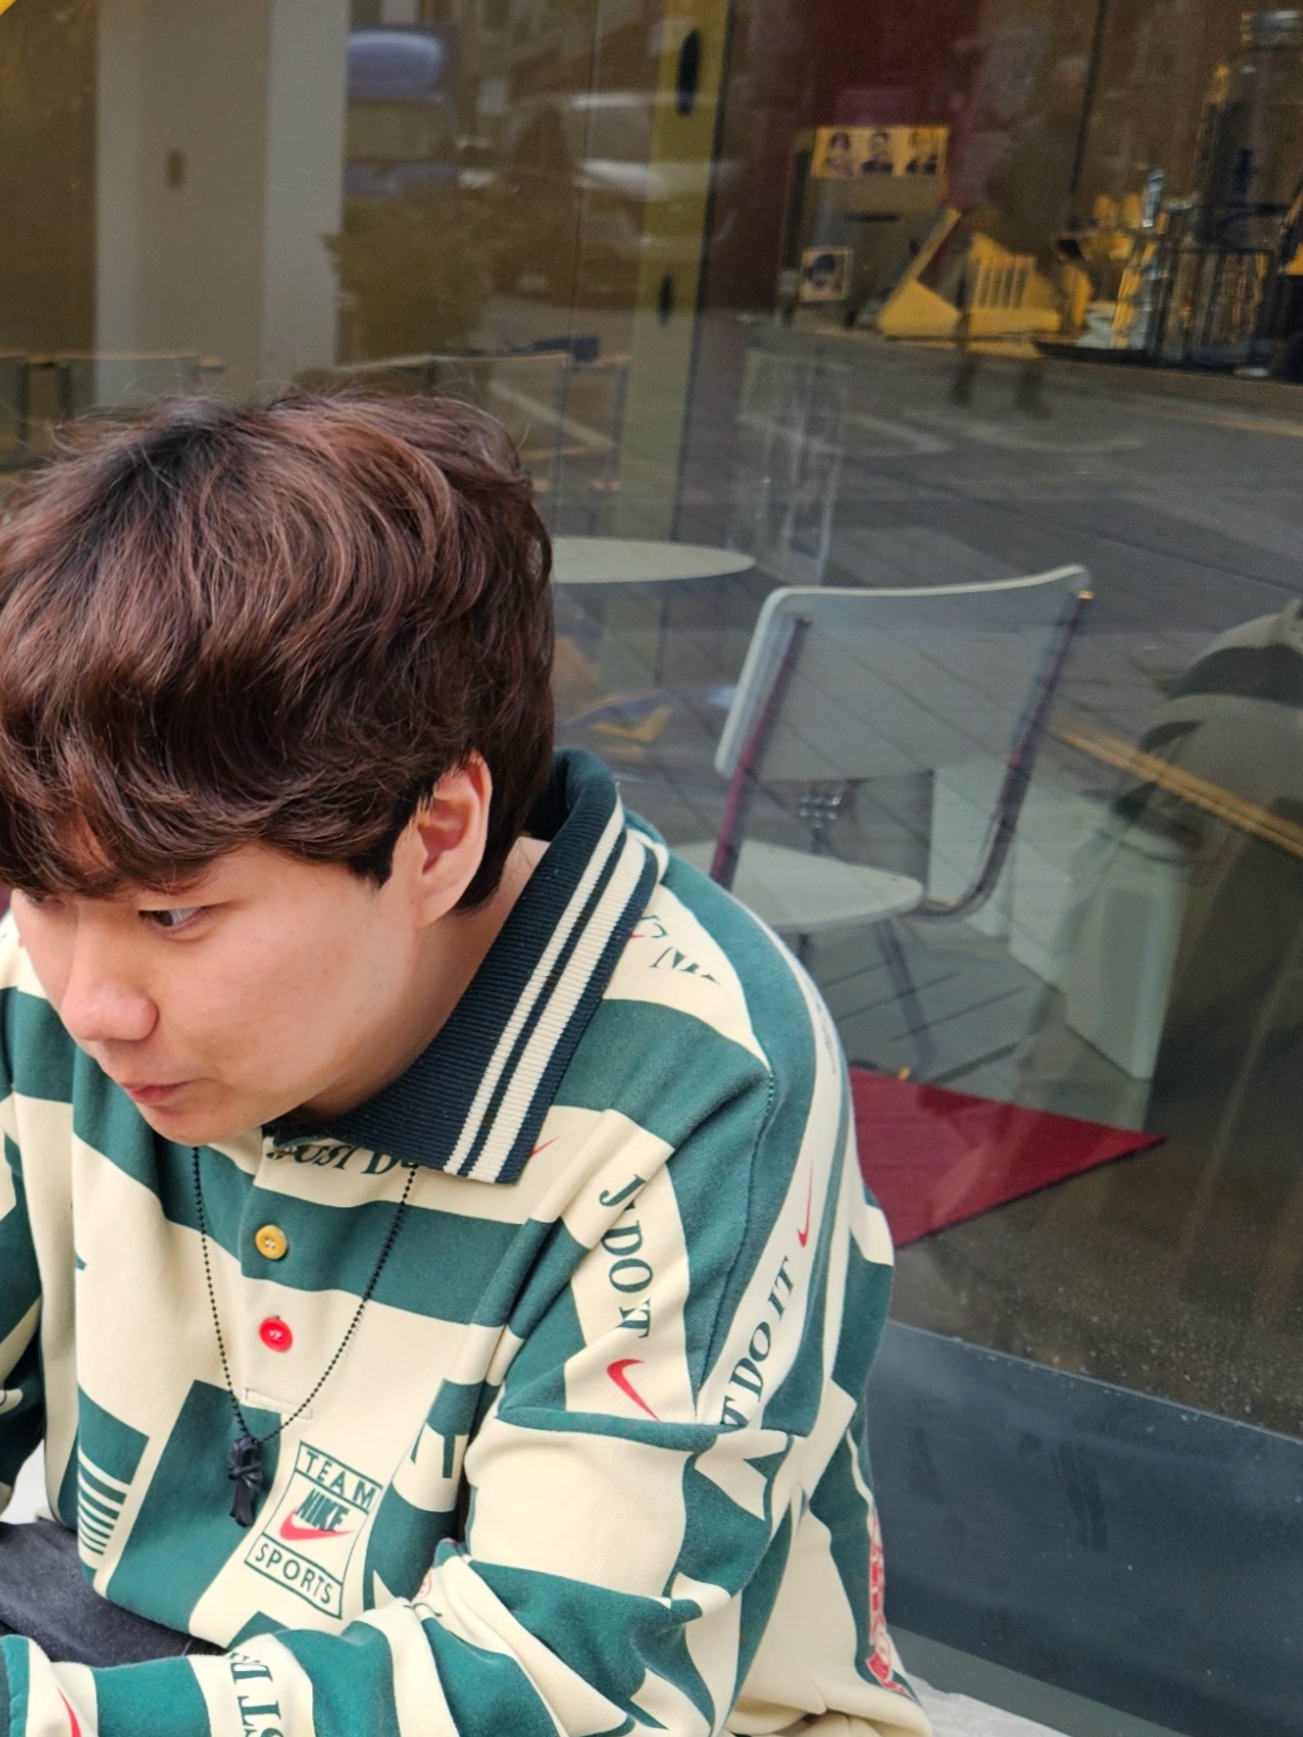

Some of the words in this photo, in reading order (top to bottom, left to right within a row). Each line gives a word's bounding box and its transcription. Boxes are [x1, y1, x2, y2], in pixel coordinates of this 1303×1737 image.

[360, 1150, 419, 1175] D
[601, 1220, 653, 1294] DO
[728, 1321, 772, 1402] DO
[766, 1254, 794, 1322] IT
[293, 1487, 351, 1533] NIKE
[300, 1449, 378, 1512] TEAM
[254, 1542, 334, 1605] SPORTS
